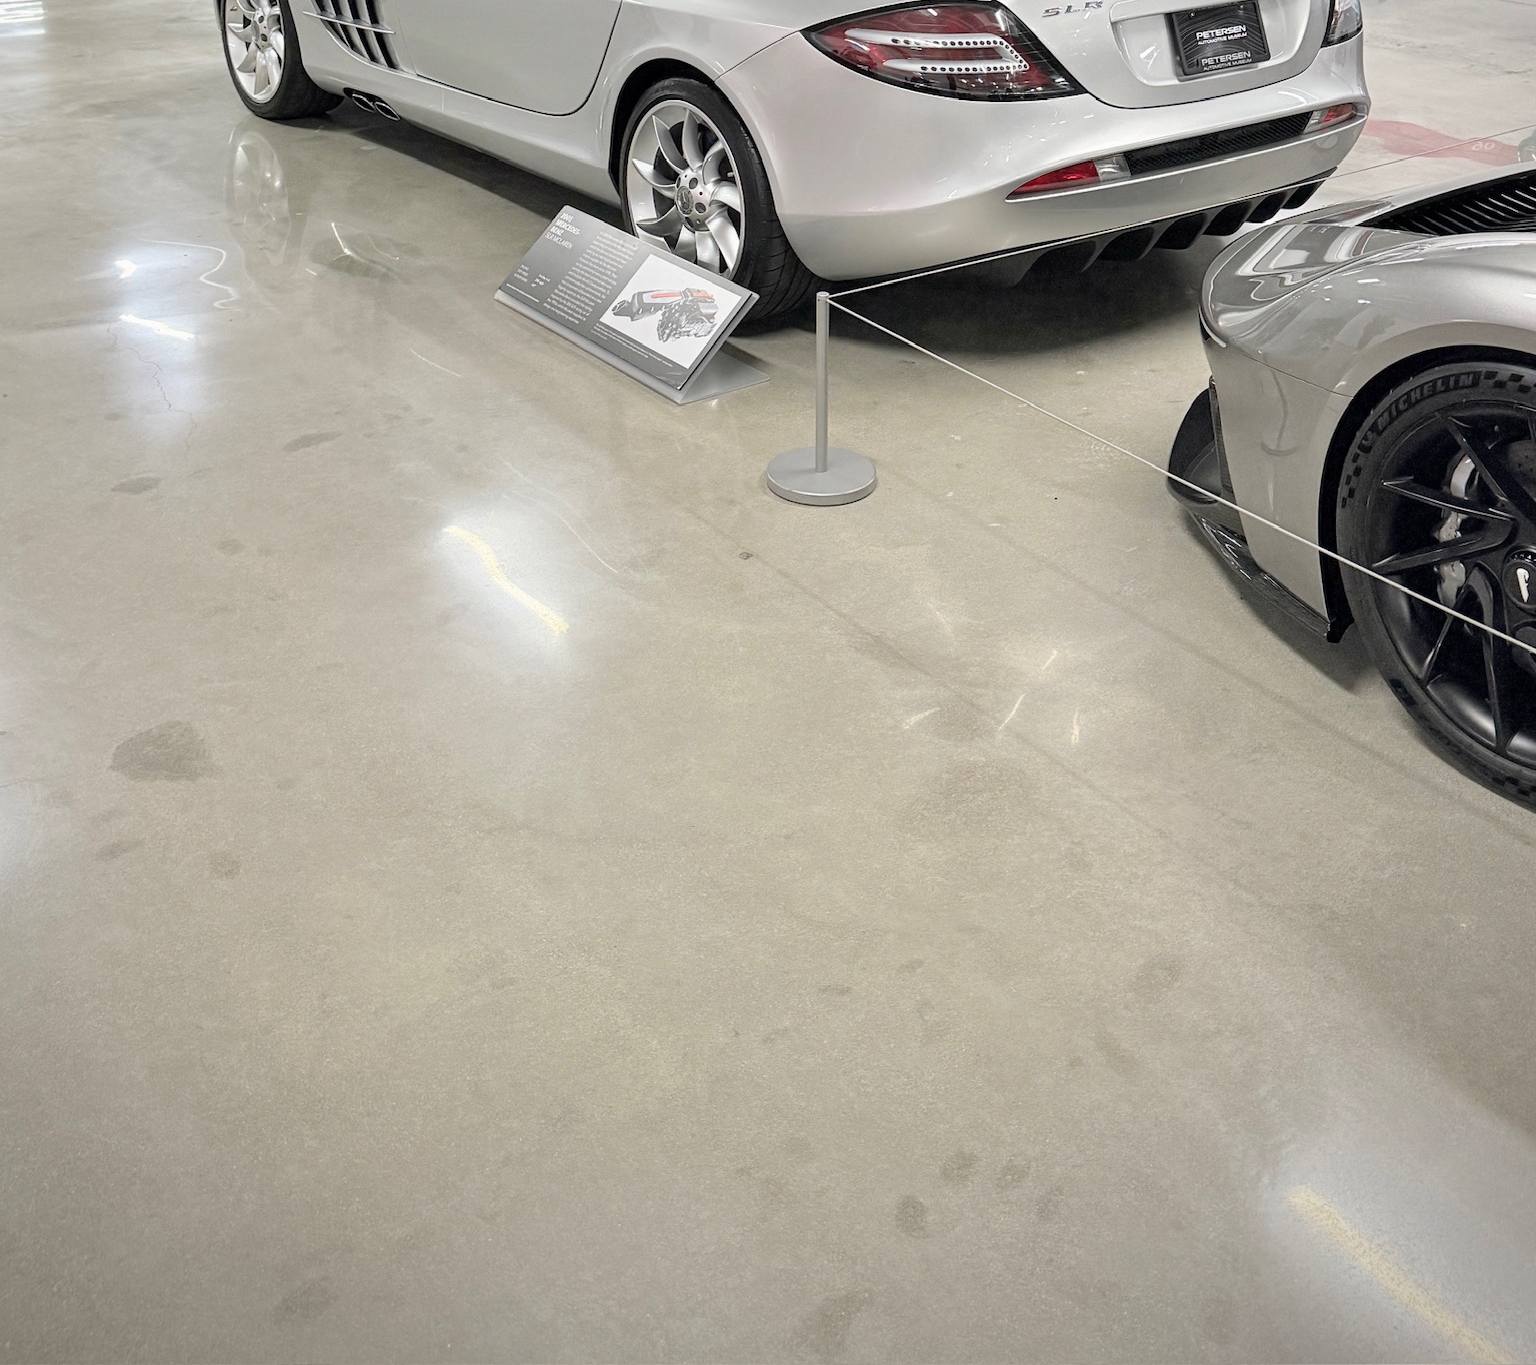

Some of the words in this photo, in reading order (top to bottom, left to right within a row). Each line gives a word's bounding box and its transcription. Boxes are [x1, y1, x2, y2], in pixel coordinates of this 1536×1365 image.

[1042, 0, 1103, 18] SLR
[1196, 24, 1247, 40] PETERSEN
[1197, 36, 1228, 45] AUTOMOTIVE
[1227, 32, 1248, 40] MUSEUM
[1201, 50, 1251, 66] PETERSEN
[1203, 62, 1232, 71] AUTOMOTIVE
[1232, 58, 1253, 66] MUSEUM
[545, 232, 555, 242] SLR
[549, 225, 564, 236] BENZ
[1377, 373, 1475, 431] MICHELIN
